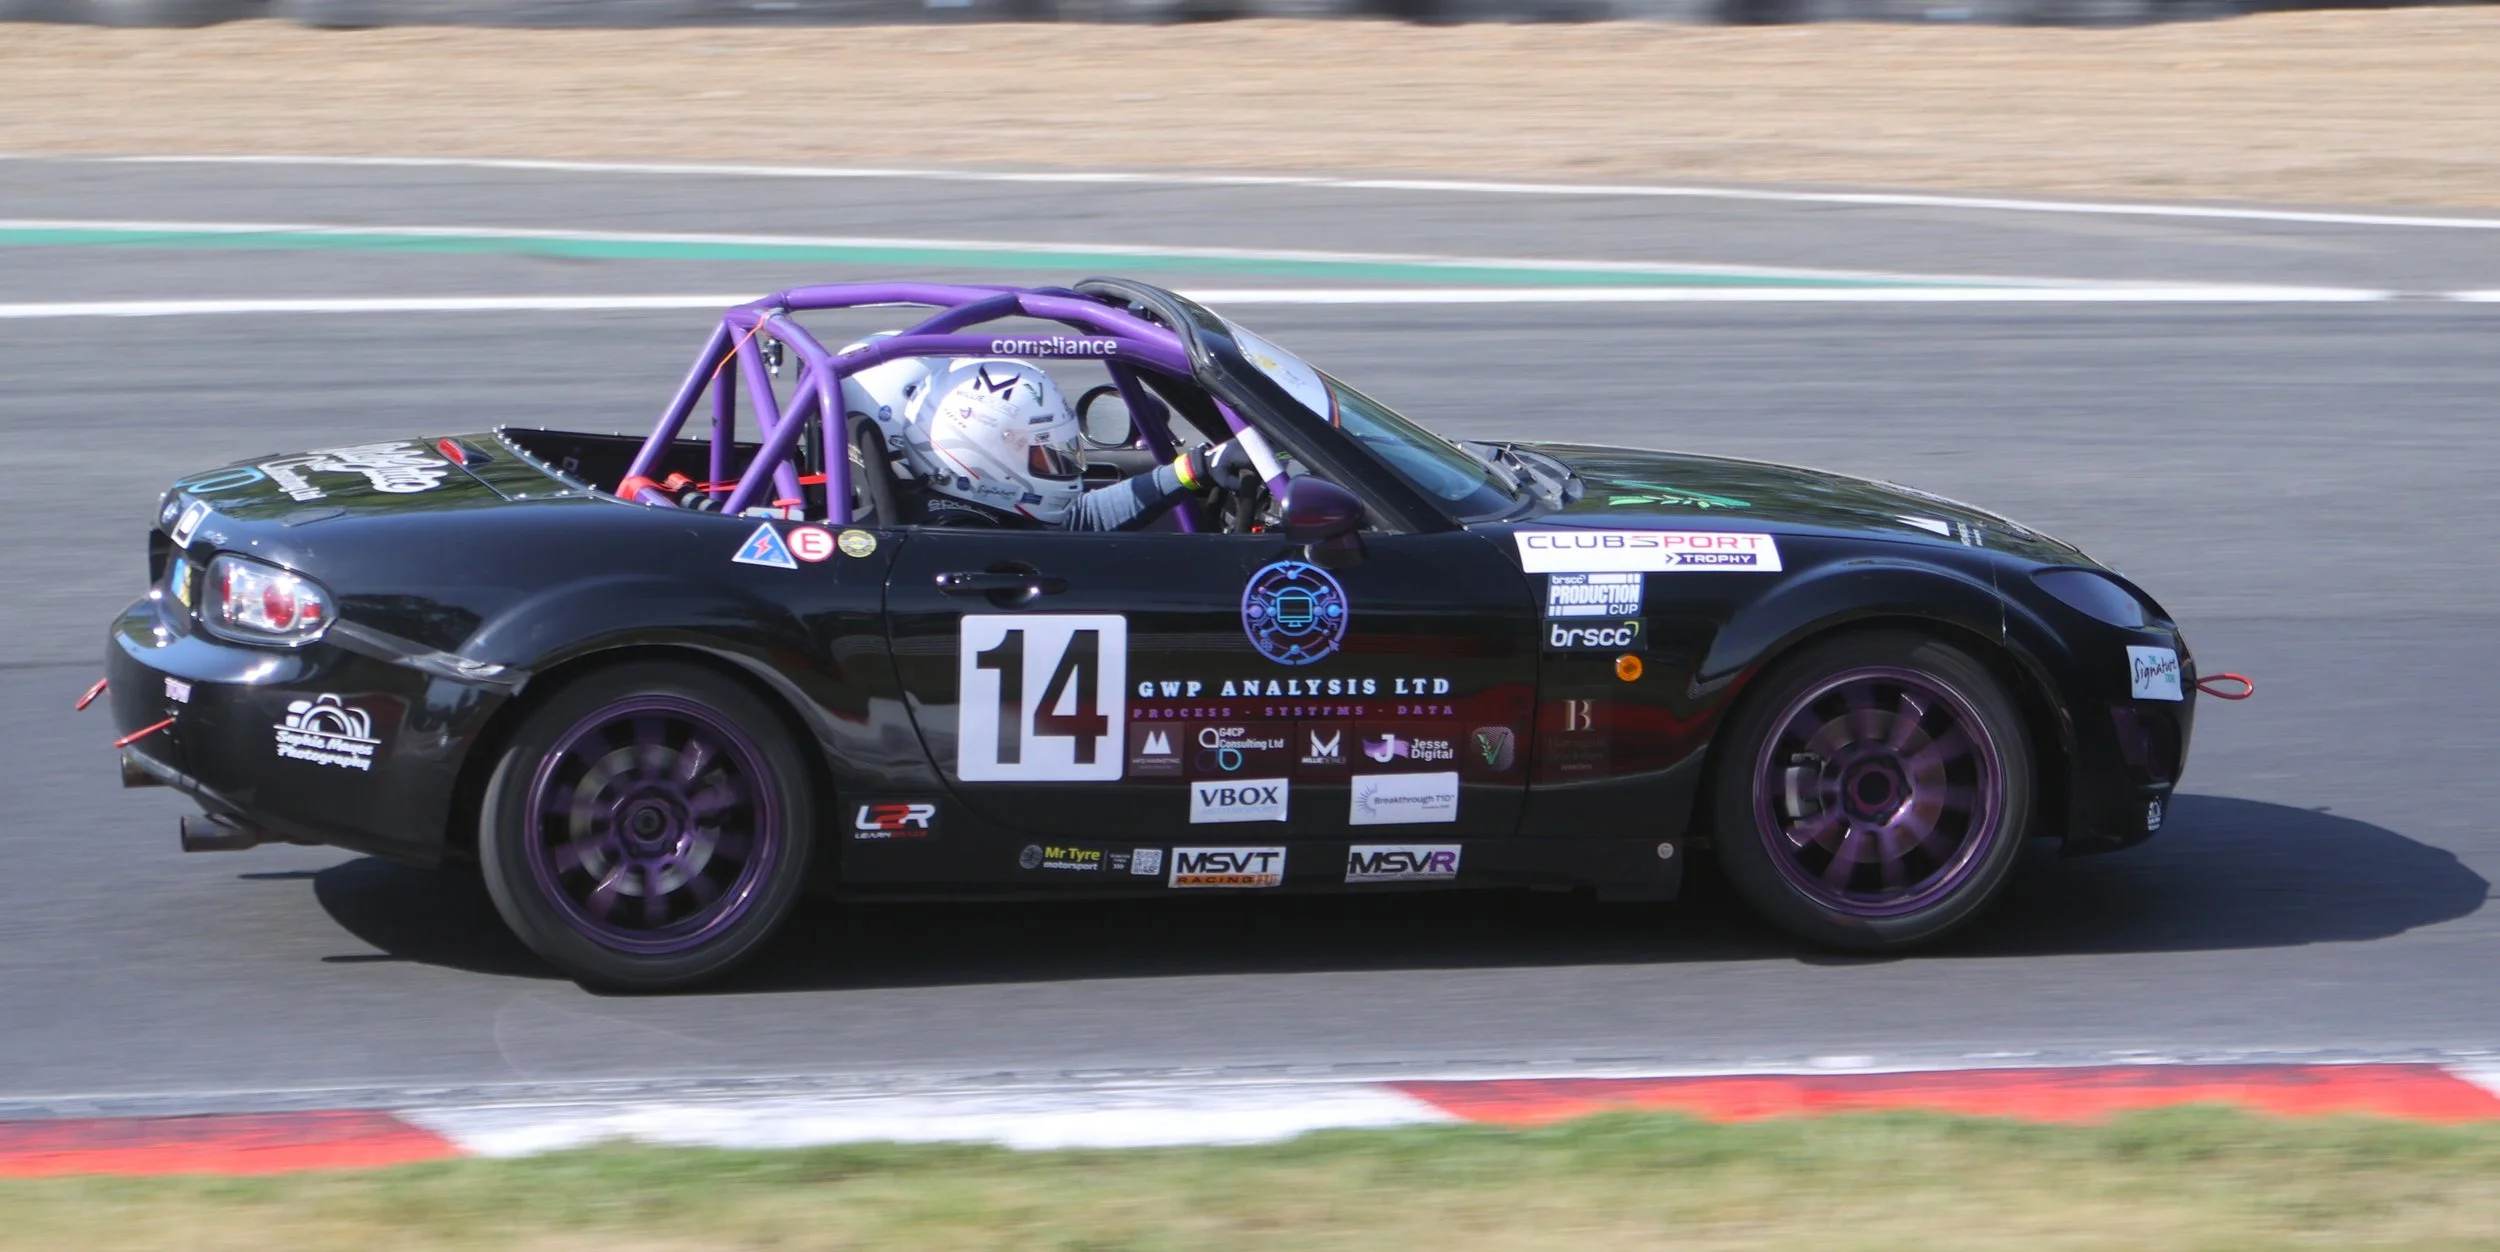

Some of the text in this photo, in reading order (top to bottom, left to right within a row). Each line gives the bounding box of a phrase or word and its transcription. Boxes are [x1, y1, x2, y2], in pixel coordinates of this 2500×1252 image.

[991, 336, 1117, 357] compliance
[801, 532, 823, 554] E
[1527, 535, 1762, 549] CLUBSPORT
[1683, 554, 1751, 564] TROPHY
[1551, 574, 1586, 585] brscc
[1550, 584, 1640, 605] PRODUCTION
[1609, 604, 1638, 615] CUP
[1551, 624, 1632, 648] brscc
[2135, 657, 2177, 690] Signature
[1138, 678, 1449, 698] GWP ANALYSIS LTD
[976, 629, 1109, 764] 14
[1133, 706, 1231, 719] PROCESS
[1397, 705, 1453, 716] DATA
[1219, 727, 1245, 738] G4CP
[1219, 738, 1284, 751] Consulting Ltd
[1411, 738, 1448, 750] Jesse
[276, 743, 371, 771] Photography
[1411, 748, 1454, 761] Digital
[1200, 786, 1279, 807] VBOX
[1374, 794, 1434, 805] Breakthrough
[855, 804, 936, 830] L2R
[1045, 847, 1066, 858] Mr
[1068, 848, 1100, 862] Tyre
[1349, 851, 1456, 873] MSVR
[1043, 861, 1098, 871] motorsport
[1177, 852, 1280, 873] MSVT
[1177, 876, 1254, 884] RACING
